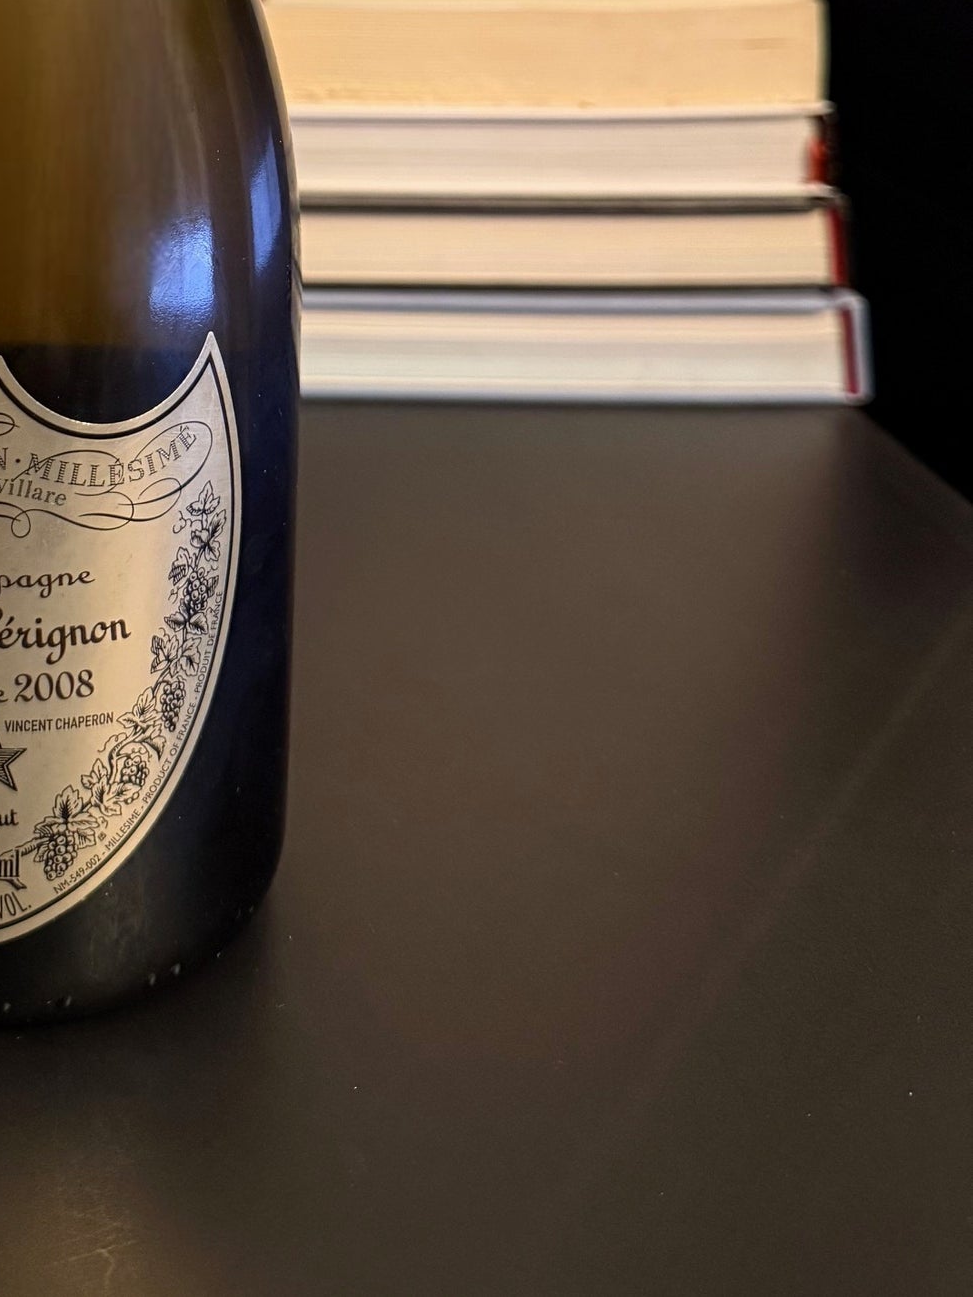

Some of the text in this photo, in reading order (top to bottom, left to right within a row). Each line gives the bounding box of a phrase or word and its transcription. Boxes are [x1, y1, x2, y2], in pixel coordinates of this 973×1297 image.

[13, 668, 96, 703] 2008
[4, 711, 115, 733] VINCENT CHAPERON
[141, 759, 173, 804] PRODUCT
[169, 741, 180, 757] OF
[176, 702, 196, 742] FRANCE
[193, 650, 212, 694] PRODUIT
[206, 634, 216, 647] DE
